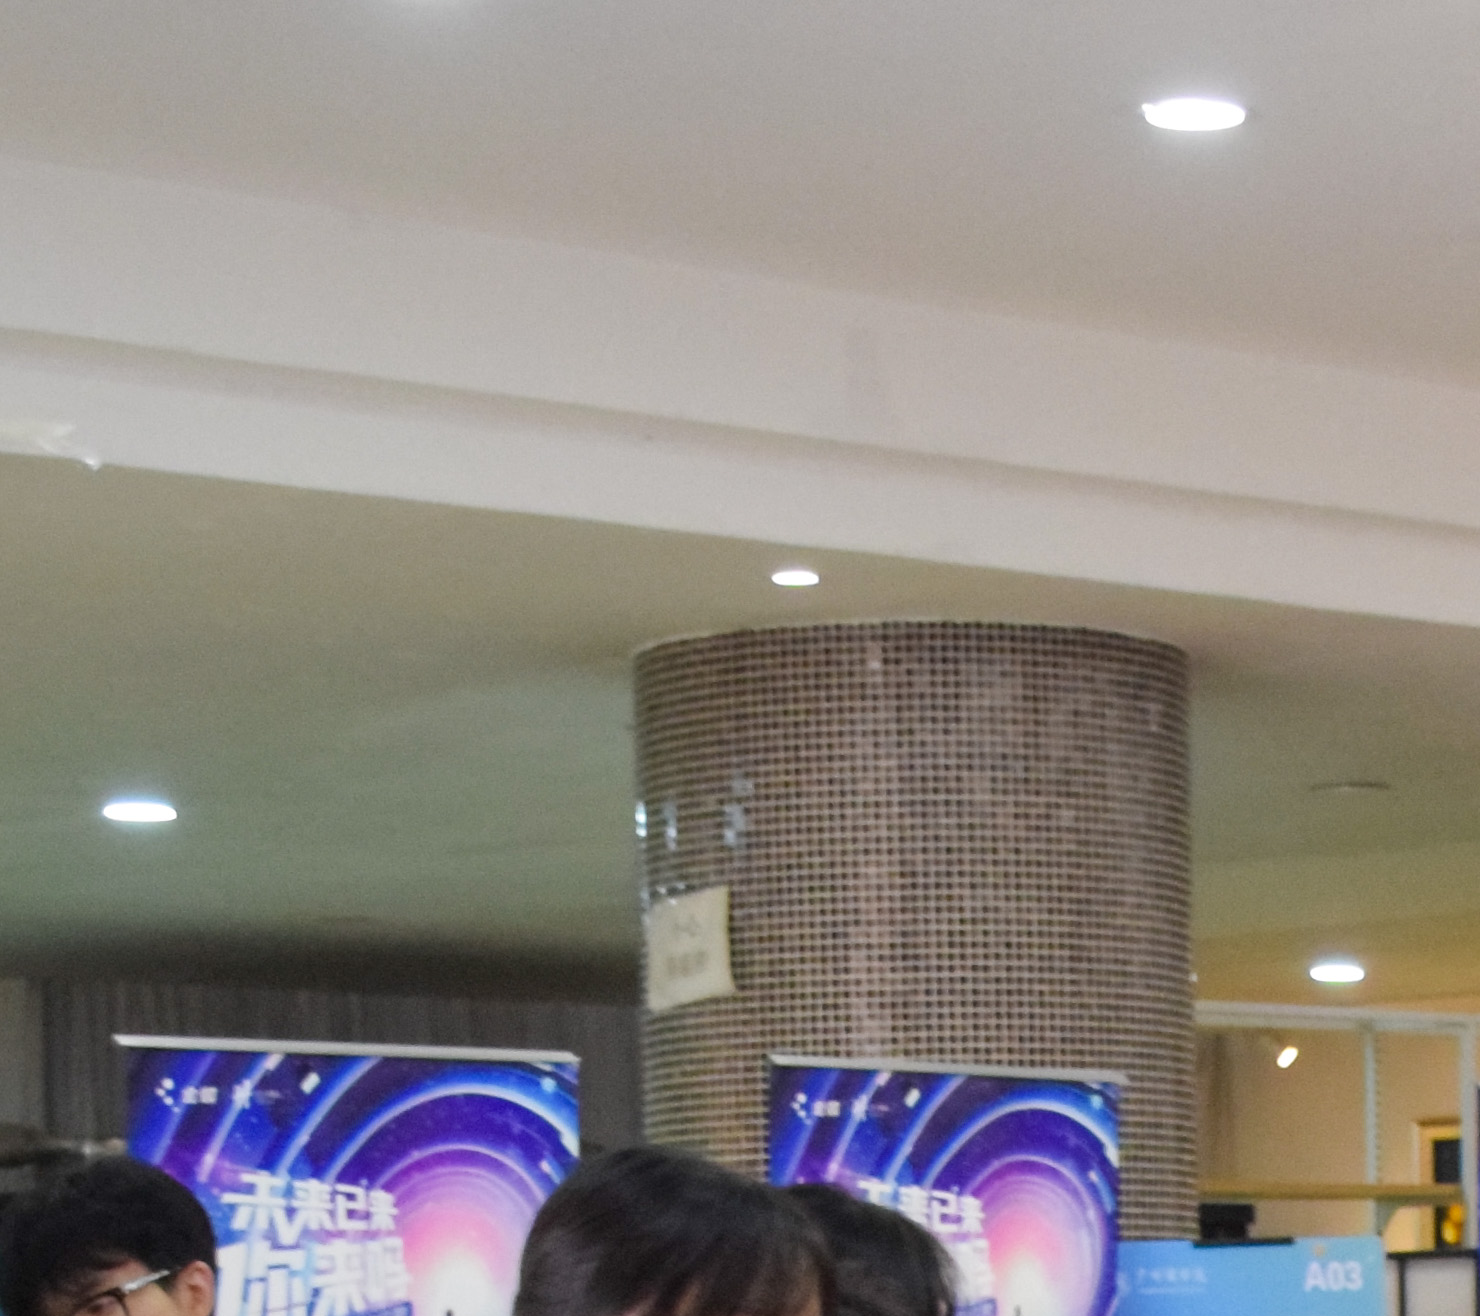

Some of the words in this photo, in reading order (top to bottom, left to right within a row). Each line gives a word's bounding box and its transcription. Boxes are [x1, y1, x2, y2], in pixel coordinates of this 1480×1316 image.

[220, 1171, 398, 1246] 未来已来
[1303, 1260, 1363, 1292] A03
